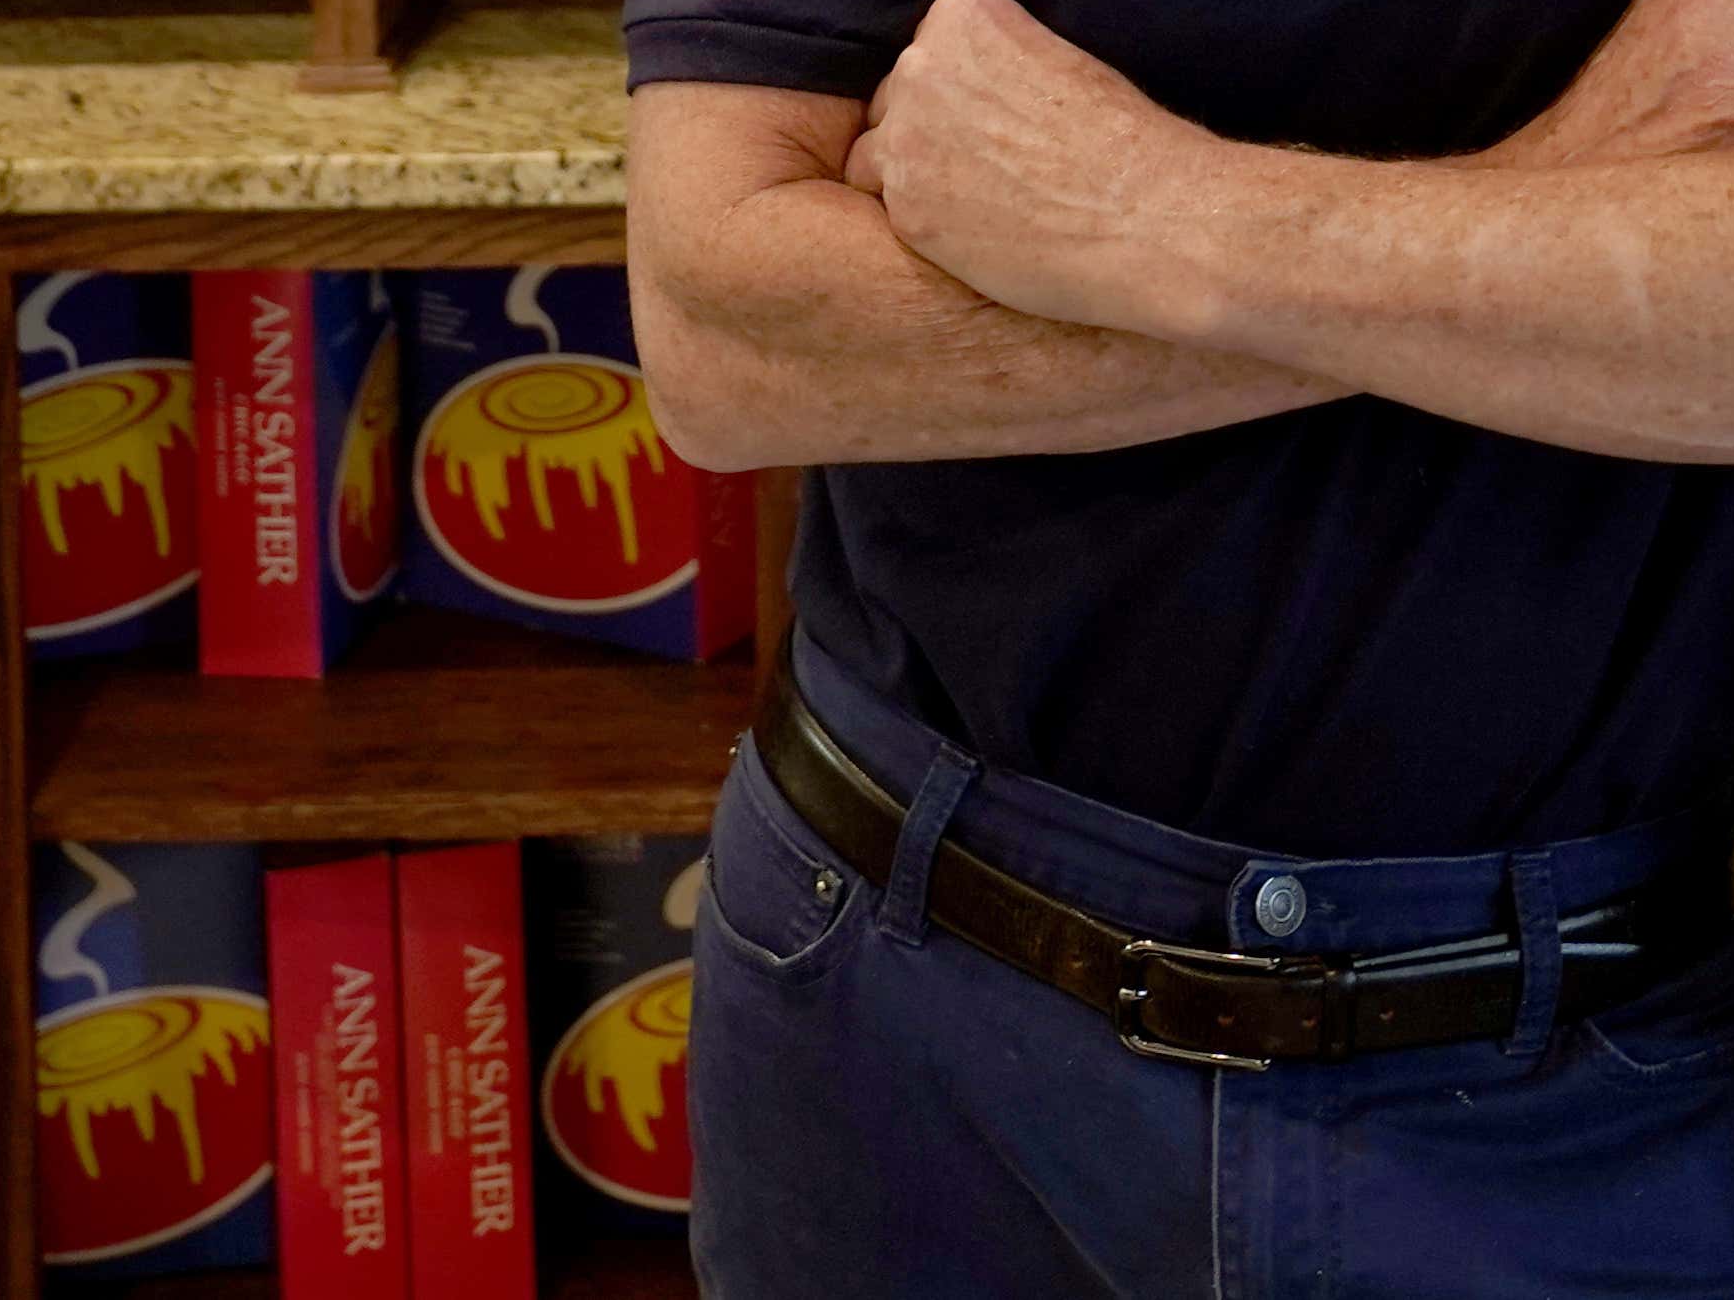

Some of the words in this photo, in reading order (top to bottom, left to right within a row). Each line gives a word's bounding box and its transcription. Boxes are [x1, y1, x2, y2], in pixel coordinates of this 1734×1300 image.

[252, 296, 294, 404] ANN
[253, 412, 297, 584] SATHER
[332, 963, 377, 1071] ANN
[463, 945, 507, 1055] ANN
[339, 1077, 384, 1254] SATHER
[468, 1059, 514, 1236] SATHER
